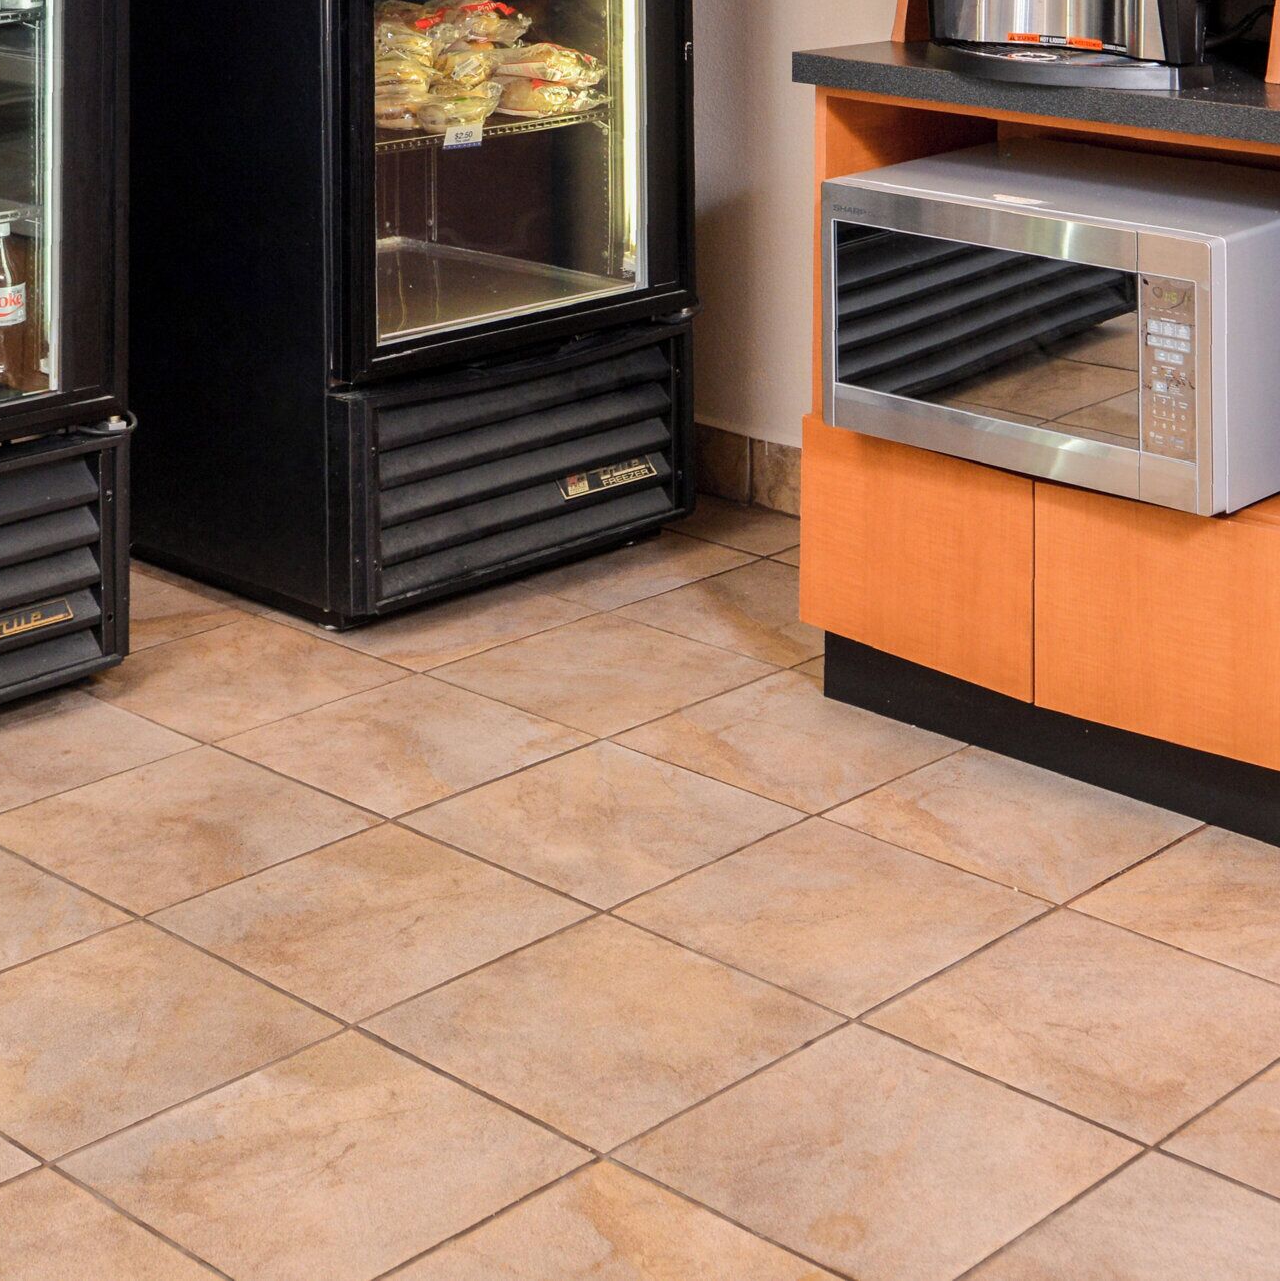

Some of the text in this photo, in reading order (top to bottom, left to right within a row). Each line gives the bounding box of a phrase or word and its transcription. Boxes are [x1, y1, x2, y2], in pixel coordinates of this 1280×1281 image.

[454, 131, 473, 140] $2.50
[832, 204, 867, 216] SHARP
[601, 469, 650, 487] FREEZER
